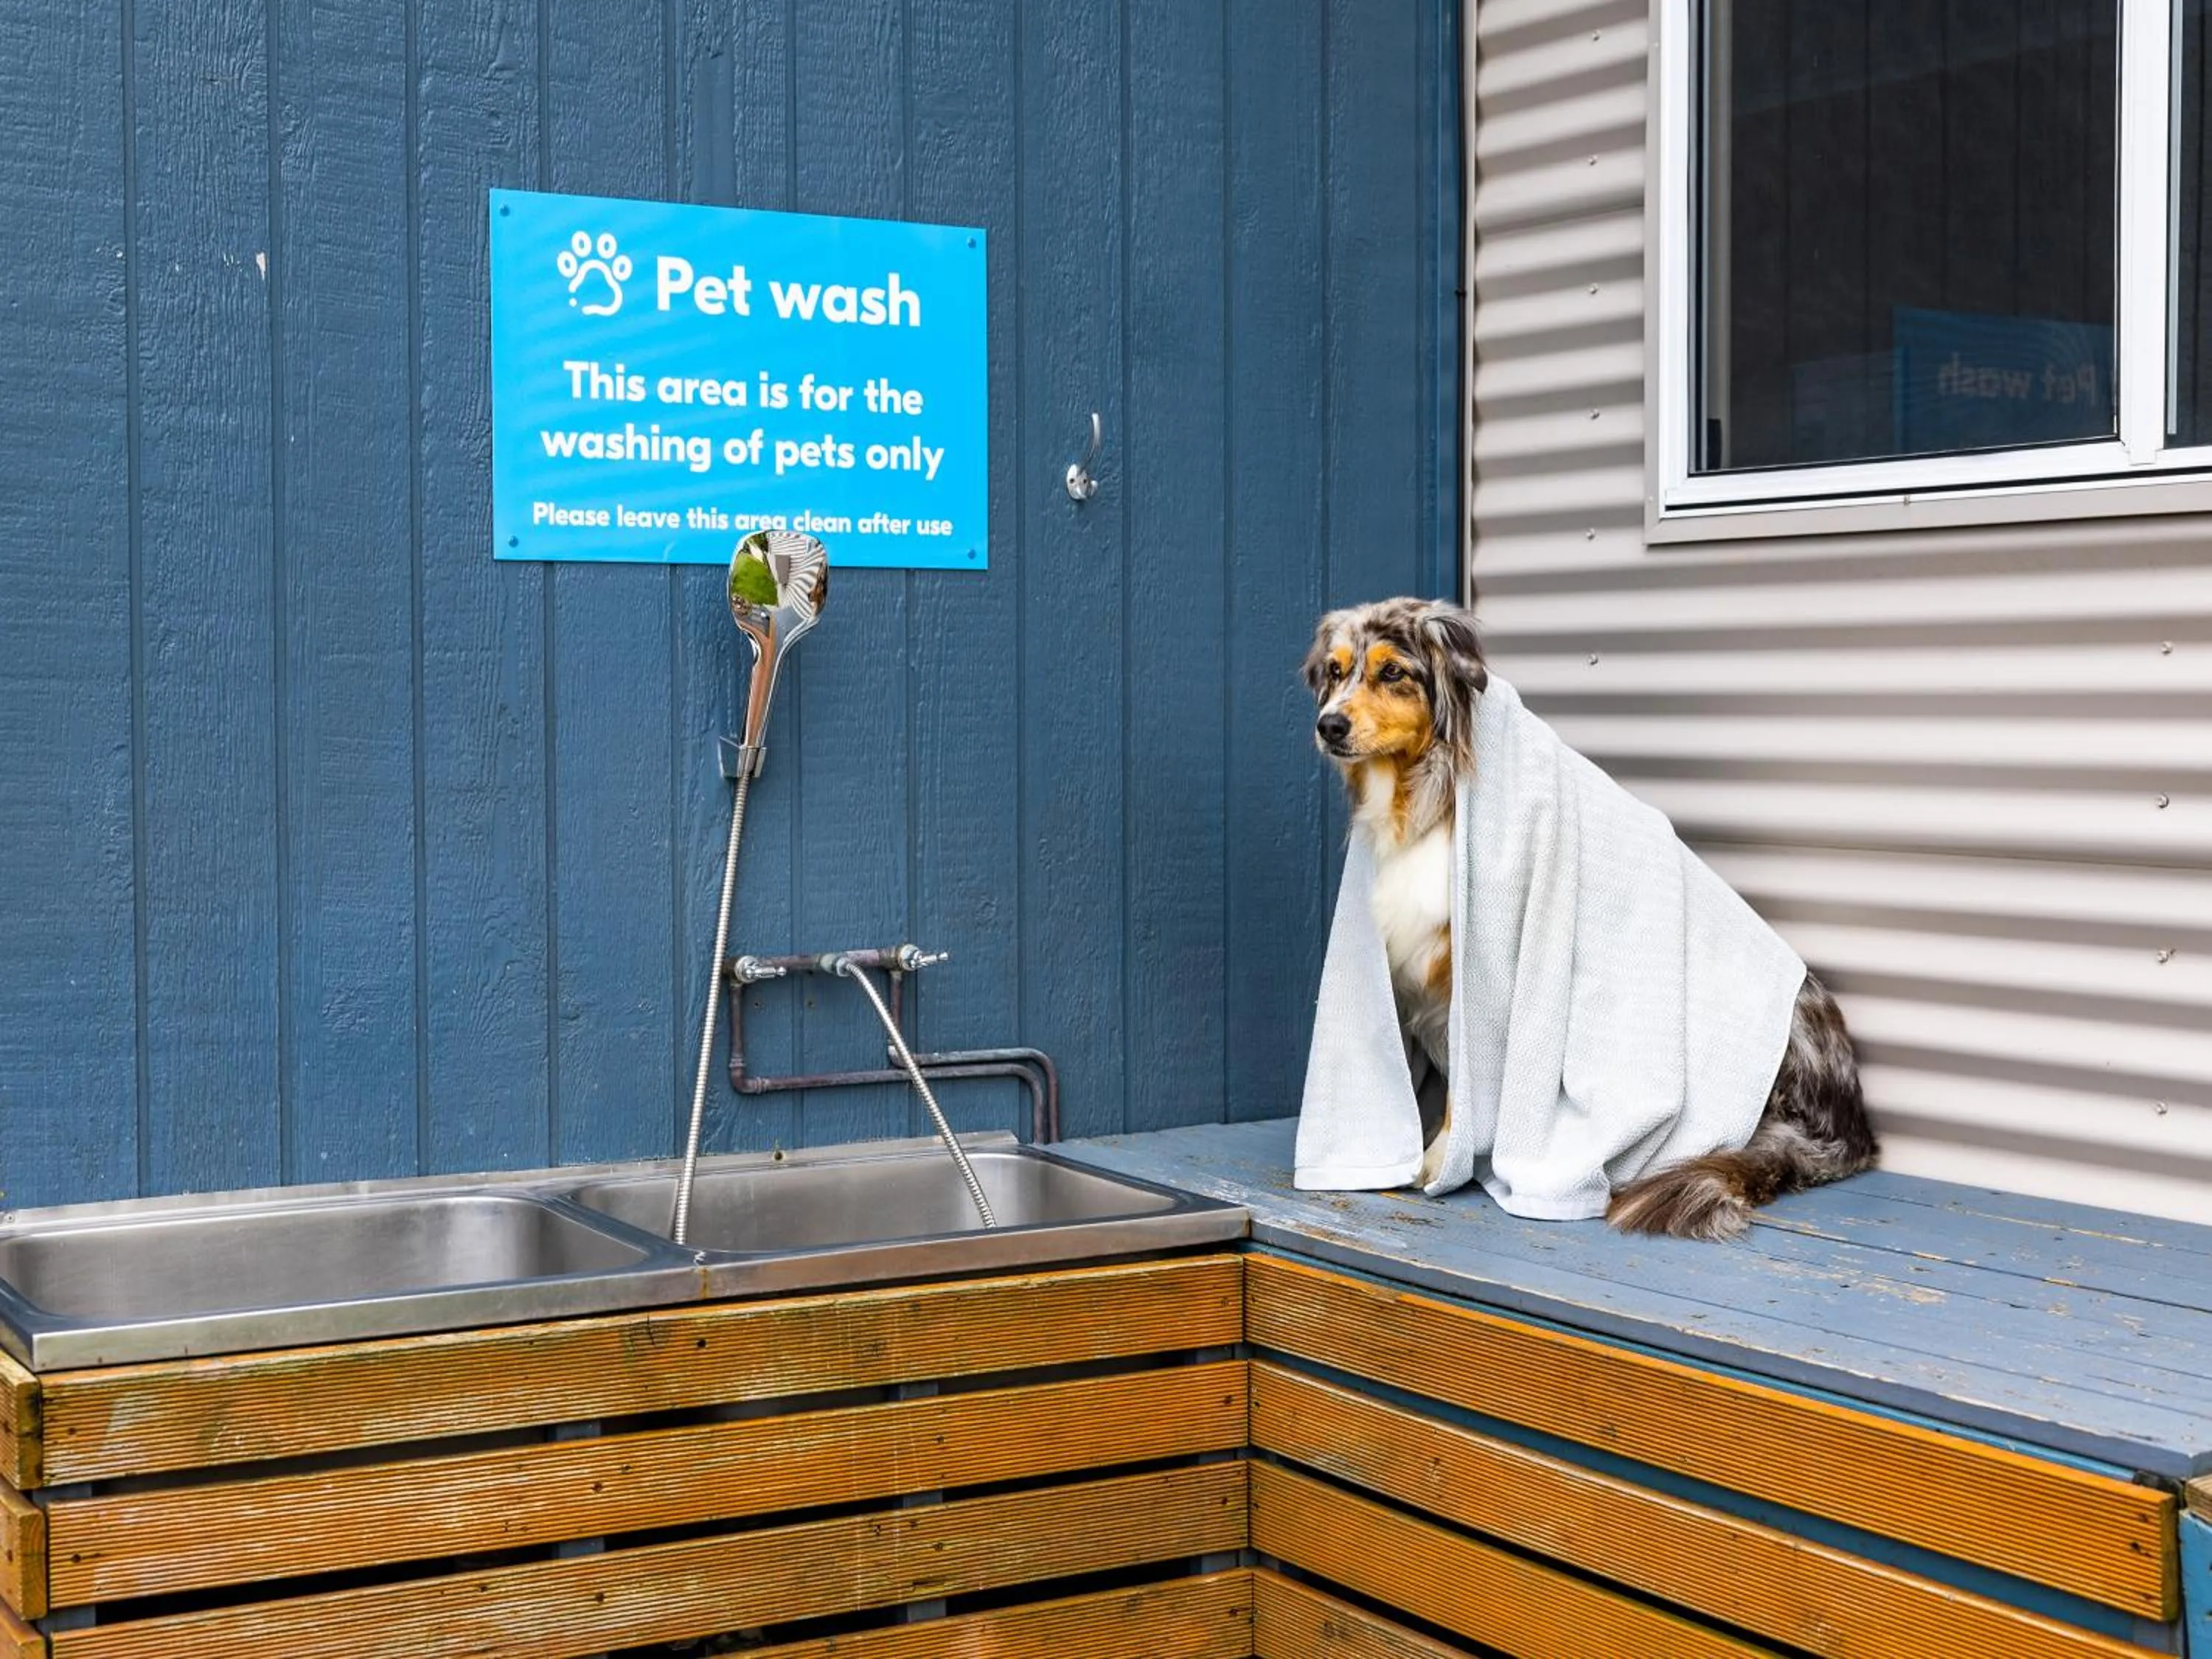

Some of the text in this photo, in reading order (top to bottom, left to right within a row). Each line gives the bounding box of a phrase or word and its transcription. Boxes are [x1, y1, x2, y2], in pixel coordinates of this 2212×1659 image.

[656, 256, 920, 327] Pet wash
[563, 361, 922, 414] This area is for the
[541, 423, 945, 480] washing of pets only
[533, 501, 953, 536] Please leave this area clean after use
